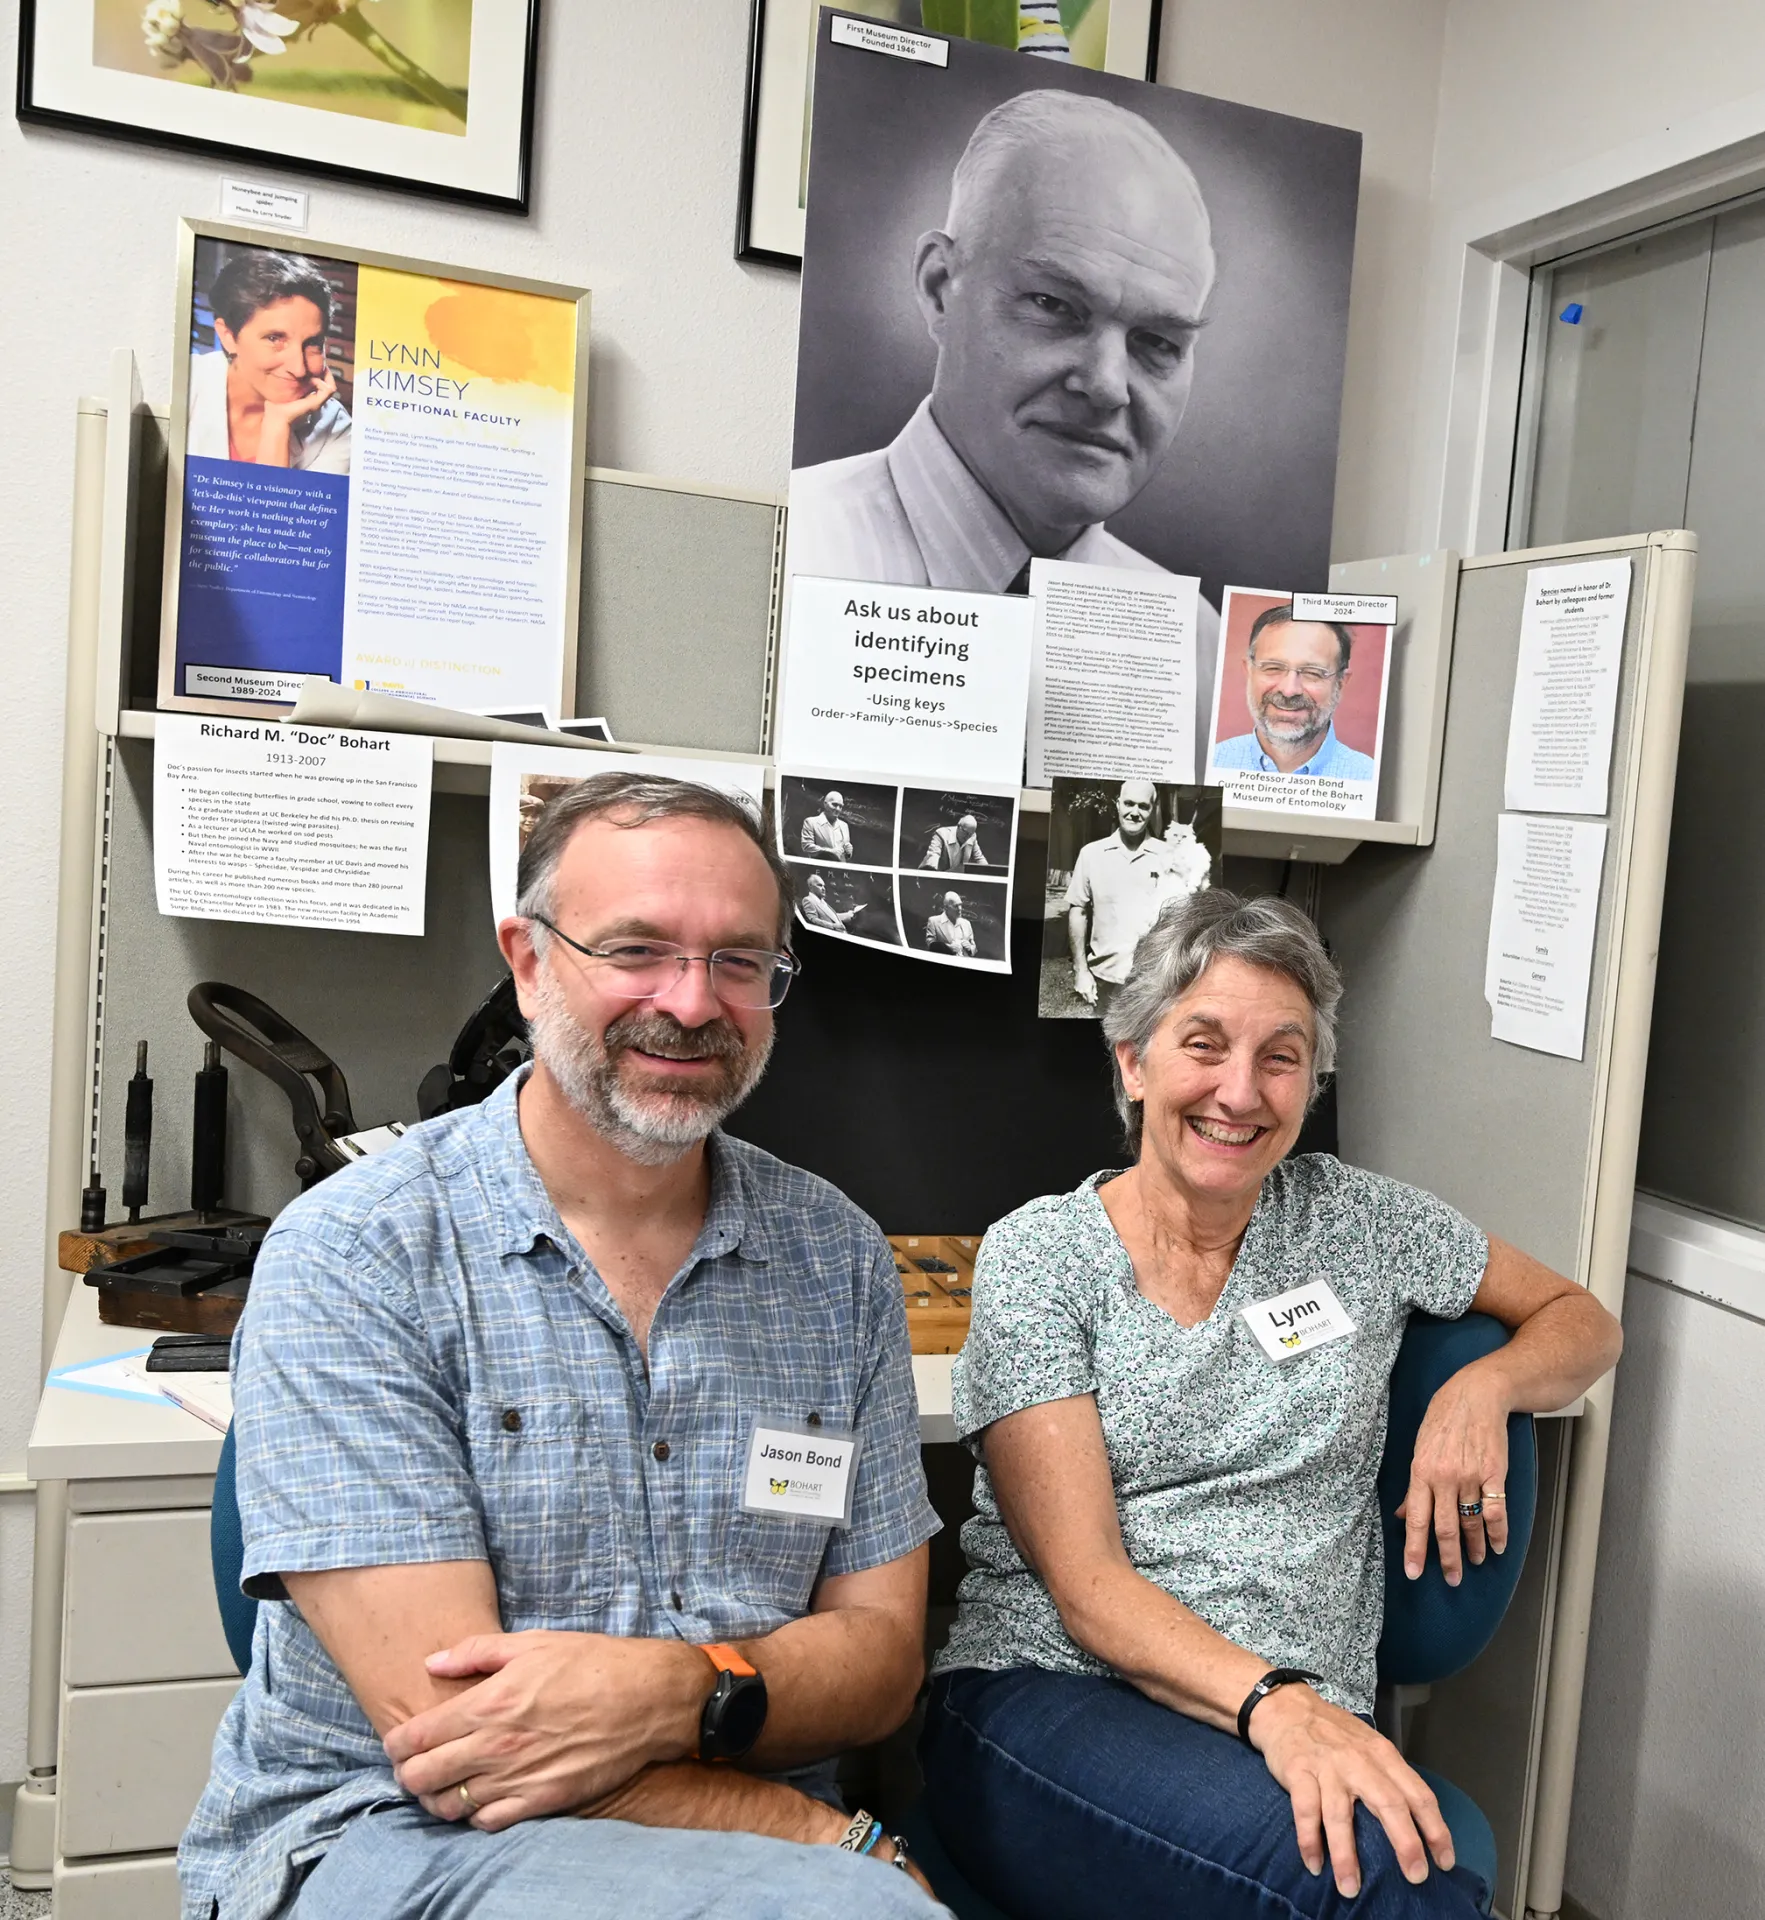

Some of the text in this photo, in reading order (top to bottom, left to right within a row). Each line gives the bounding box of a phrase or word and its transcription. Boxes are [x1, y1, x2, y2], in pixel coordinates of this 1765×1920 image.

[846, 23, 931, 48] First Museum Director
[861, 36, 915, 54] Founded 1946
[370, 339, 439, 368] LYNN
[368, 367, 467, 400] KIMSEY
[366, 396, 520, 426] EXCEPTIONAL FACULTY
[212, 476, 244, 489] Kimsey
[263, 484, 302, 497] visionary
[305, 490, 323, 498] with
[246, 496, 287, 508] viewpoint
[289, 500, 306, 510] that
[308, 503, 337, 514] defines
[208, 504, 225, 513] Her
[227, 508, 249, 517] work
[261, 512, 293, 524] nothing
[295, 515, 316, 525] short
[319, 518, 327, 528] of
[240, 522, 254, 531] she
[256, 524, 271, 534] has
[273, 528, 296, 536] made
[298, 530, 311, 538] the
[190, 533, 225, 542] museum
[227, 535, 241, 544] the
[242, 537, 265, 547] place
[313, 546, 332, 557] only
[188, 559, 201, 568] the
[204, 548, 241, 560] scientific
[244, 552, 299, 565] collaborators
[301, 558, 315, 567] but
[317, 559, 329, 570] for
[844, 599, 978, 627] Ask us about
[855, 629, 968, 661] identifying
[196, 673, 231, 683] Second
[234, 676, 274, 686] Museum
[853, 665, 965, 687] specimens
[231, 686, 280, 696] 1989-2024
[867, 693, 944, 713] -Using keys
[811, 707, 997, 732] Order->Family->Genus->Species
[200, 723, 389, 750] Richard M. “Doc” Bohart
[266, 753, 325, 766] 1913-2007
[1218, 780, 1254, 791] Current
[1257, 783, 1296, 794] Director
[1311, 788, 1327, 797] the
[1330, 790, 1362, 800] Bohart
[1239, 771, 1343, 788] Professor Jason Bond
[220, 790, 252, 798] collecting
[1232, 792, 1273, 802] Museum
[1288, 797, 1346, 811] Entomology
[280, 812, 308, 820] Berkeley
[1268, 1301, 1321, 1327] Lynn
[1299, 1319, 1331, 1336] BOHART
[760, 1445, 841, 1468] Jason Bond
[790, 1480, 823, 1491] BOHART
